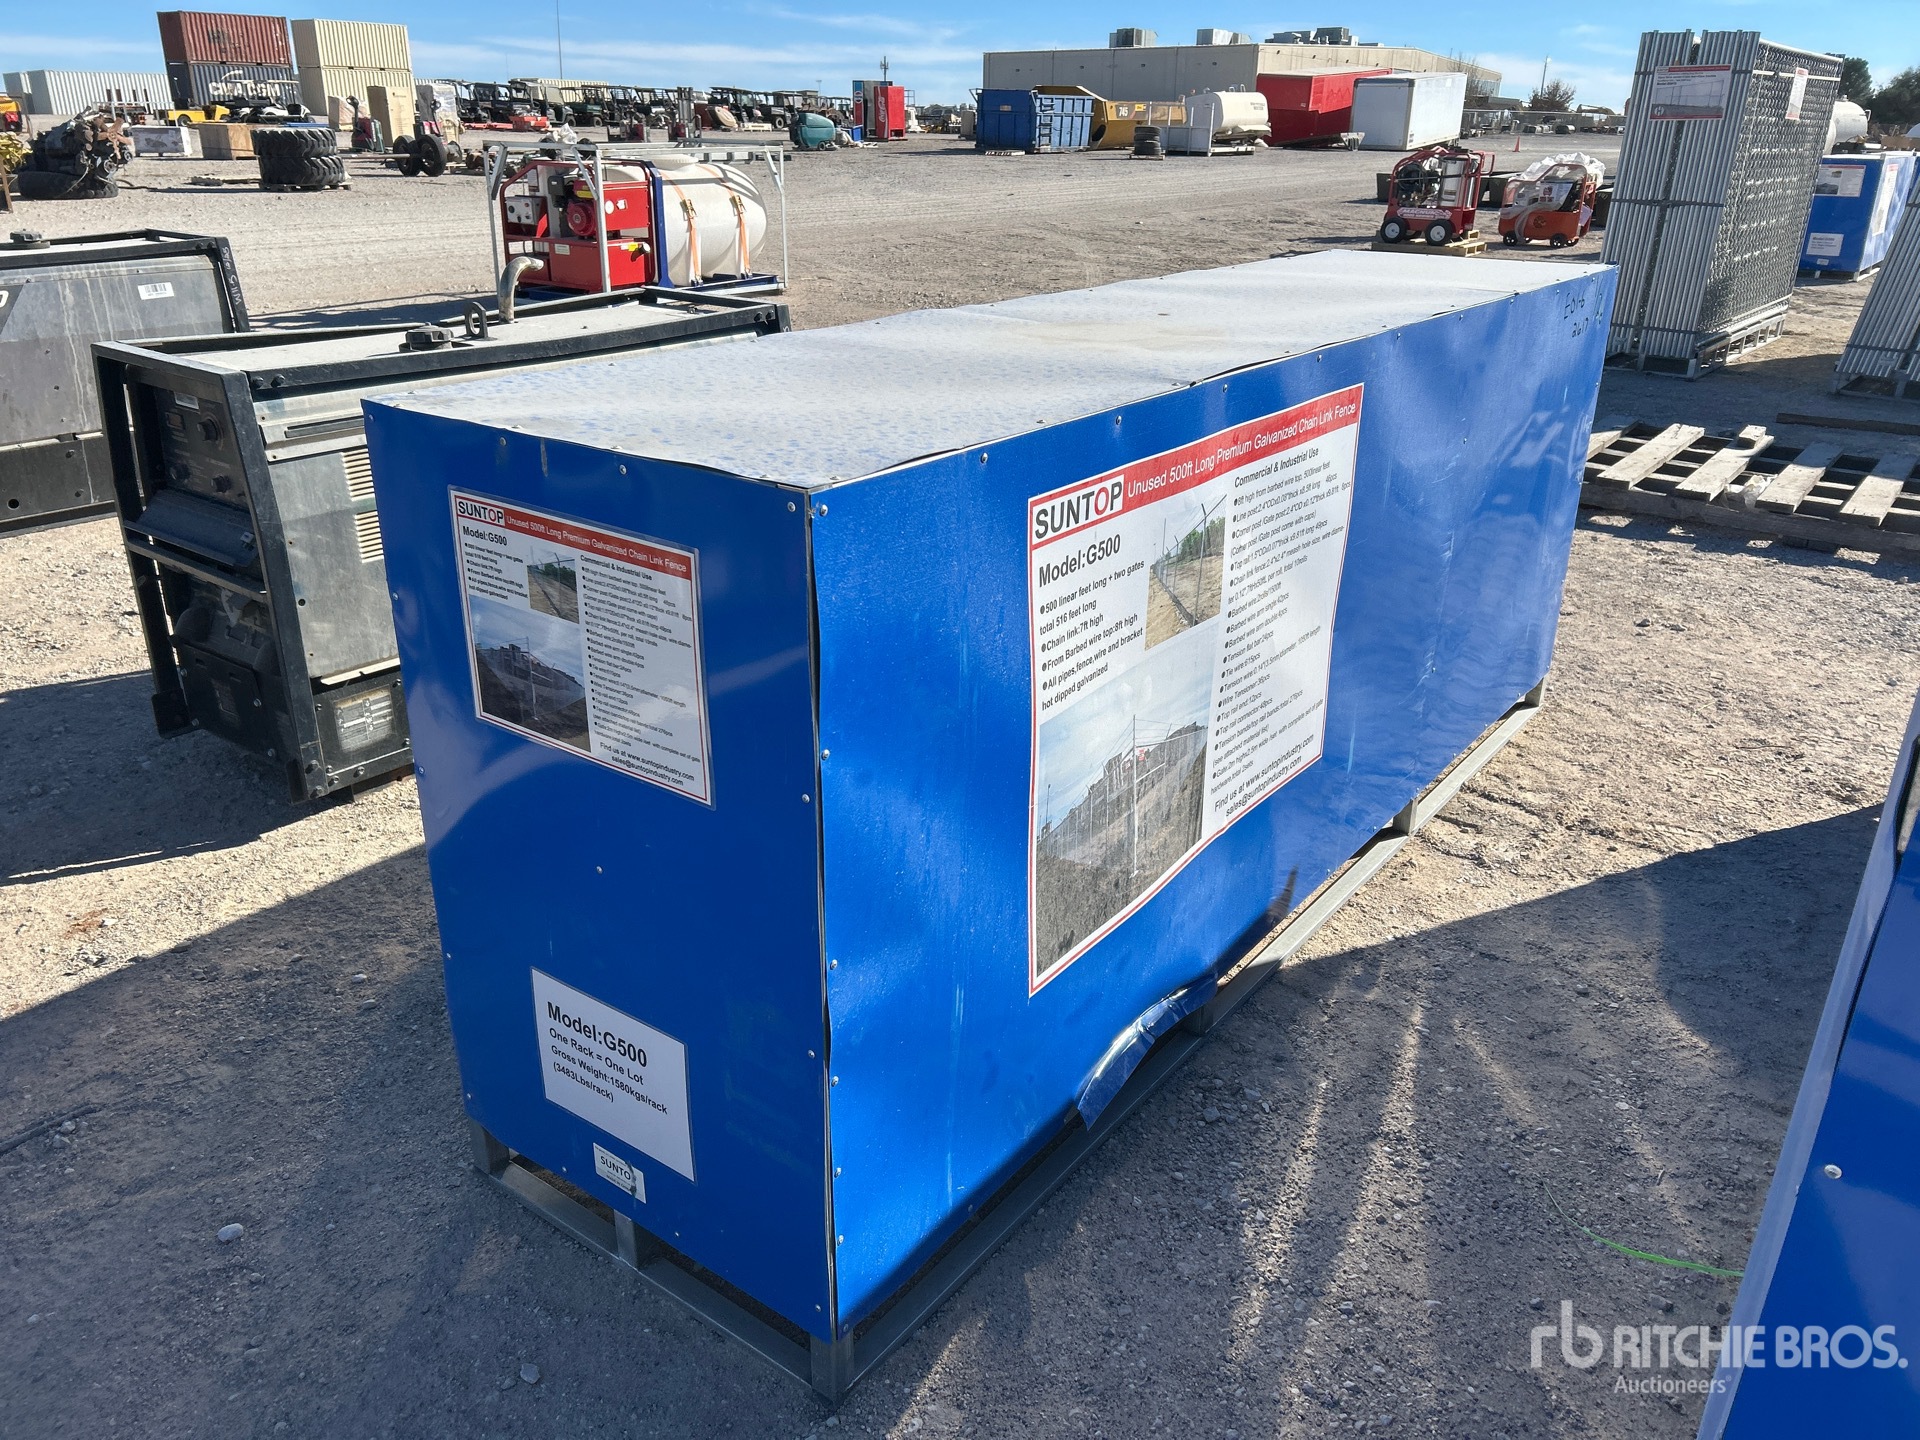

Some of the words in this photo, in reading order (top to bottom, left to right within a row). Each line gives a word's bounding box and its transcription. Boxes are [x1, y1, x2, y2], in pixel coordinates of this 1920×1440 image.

[1119, 106, 1129, 117] 745
[1034, 481, 1122, 540] SUNTOP
[1128, 470, 1167, 498] Unused
[1169, 461, 1193, 483] 500ft
[1195, 455, 1215, 474] Long
[1216, 441, 1252, 464] Premium
[1254, 421, 1298, 449] Galvanized
[1299, 416, 1318, 433] Chain
[1319, 408, 1333, 425] Link
[1334, 403, 1356, 419] Fence
[1235, 464, 1273, 488] Commercial
[1274, 463, 1278, 473] &
[1280, 451, 1308, 470] Industrial
[1309, 448, 1319, 459] Use
[1245, 492, 1255, 503] high
[1256, 488, 1266, 498] from
[1267, 481, 1284, 493] barbed
[1285, 477, 1294, 486] wire
[1235, 525, 1251, 539] Corner
[1251, 519, 1262, 532] post
[1237, 512, 1247, 522] Line
[1271, 526, 1281, 537] post
[1281, 521, 1294, 531] come
[1305, 525, 1315, 534] long
[458, 501, 503, 524] SUNTOP
[506, 516, 529, 529] Unused
[530, 522, 545, 533] 500ft
[546, 526, 562, 540] Long
[562, 530, 590, 545] Premium
[591, 539, 627, 556] Galvanized
[628, 549, 648, 561] Chain
[649, 555, 663, 566] Link
[665, 558, 686, 572] Fence
[463, 526, 507, 546] Model:G500
[580, 554, 610, 569] Commercial
[616, 565, 641, 577] Industrial
[642, 572, 652, 581] Use
[1039, 534, 1120, 588] Model:G500
[1046, 599, 1057, 613] 500
[1059, 591, 1077, 607] linear
[1079, 583, 1091, 597] feet
[1093, 578, 1107, 590] long
[1114, 569, 1126, 580] two
[1127, 561, 1144, 576] gates
[1233, 574, 1246, 586] Chain
[1040, 619, 1054, 636] total
[1056, 612, 1067, 627] 516
[1068, 606, 1081, 620] feet
[1082, 600, 1096, 613] long
[1230, 618, 1246, 633] Barbed
[1247, 613, 1256, 622] wire
[1231, 602, 1247, 618] Barbed
[1047, 635, 1065, 651] Chain
[1067, 621, 1088, 640] link:7ft
[1089, 613, 1103, 627] high
[1047, 655, 1064, 670] From
[1065, 639, 1087, 660] Barbed
[1089, 633, 1102, 646] wire
[1103, 620, 1123, 638] top:8ft
[1124, 613, 1138, 626] high
[1229, 633, 1245, 648] Barbed
[1048, 676, 1057, 689] All
[1058, 648, 1107, 685] pipes,fence,wire
[1108, 639, 1119, 653] and
[1120, 627, 1143, 646] bracket
[1227, 648, 1246, 662] Tension
[1042, 697, 1053, 711] hot
[1054, 682, 1076, 703] dipped
[1077, 662, 1108, 692] galvanized
[1224, 677, 1243, 691] Tension
[1220, 725, 1228, 734] Top
[1221, 711, 1230, 721] Top
[1219, 733, 1236, 749] Tension
[600, 742, 612, 752] Find
[627, 753, 694, 781] www.suntopindustry.com
[611, 756, 684, 786] sales@suntopindustry.com
[1215, 794, 1228, 812] Find
[1230, 789, 1237, 800] us
[1238, 782, 1245, 794] at
[1246, 734, 1314, 788] www.suntopindustry.com
[1226, 755, 1302, 817] sales@suntopindustry.com
[547, 1001, 647, 1067] Model:G500
[549, 1028, 568, 1045] One
[571, 1038, 594, 1059] Rack
[605, 1057, 624, 1075] One
[627, 1068, 644, 1085] Lot
[551, 1045, 576, 1065] Gross
[577, 1058, 667, 1115] Weight:1580kgs/rack
[553, 1062, 614, 1103] (3483Lbs/rack)
[600, 1155, 631, 1181] SUNTO
